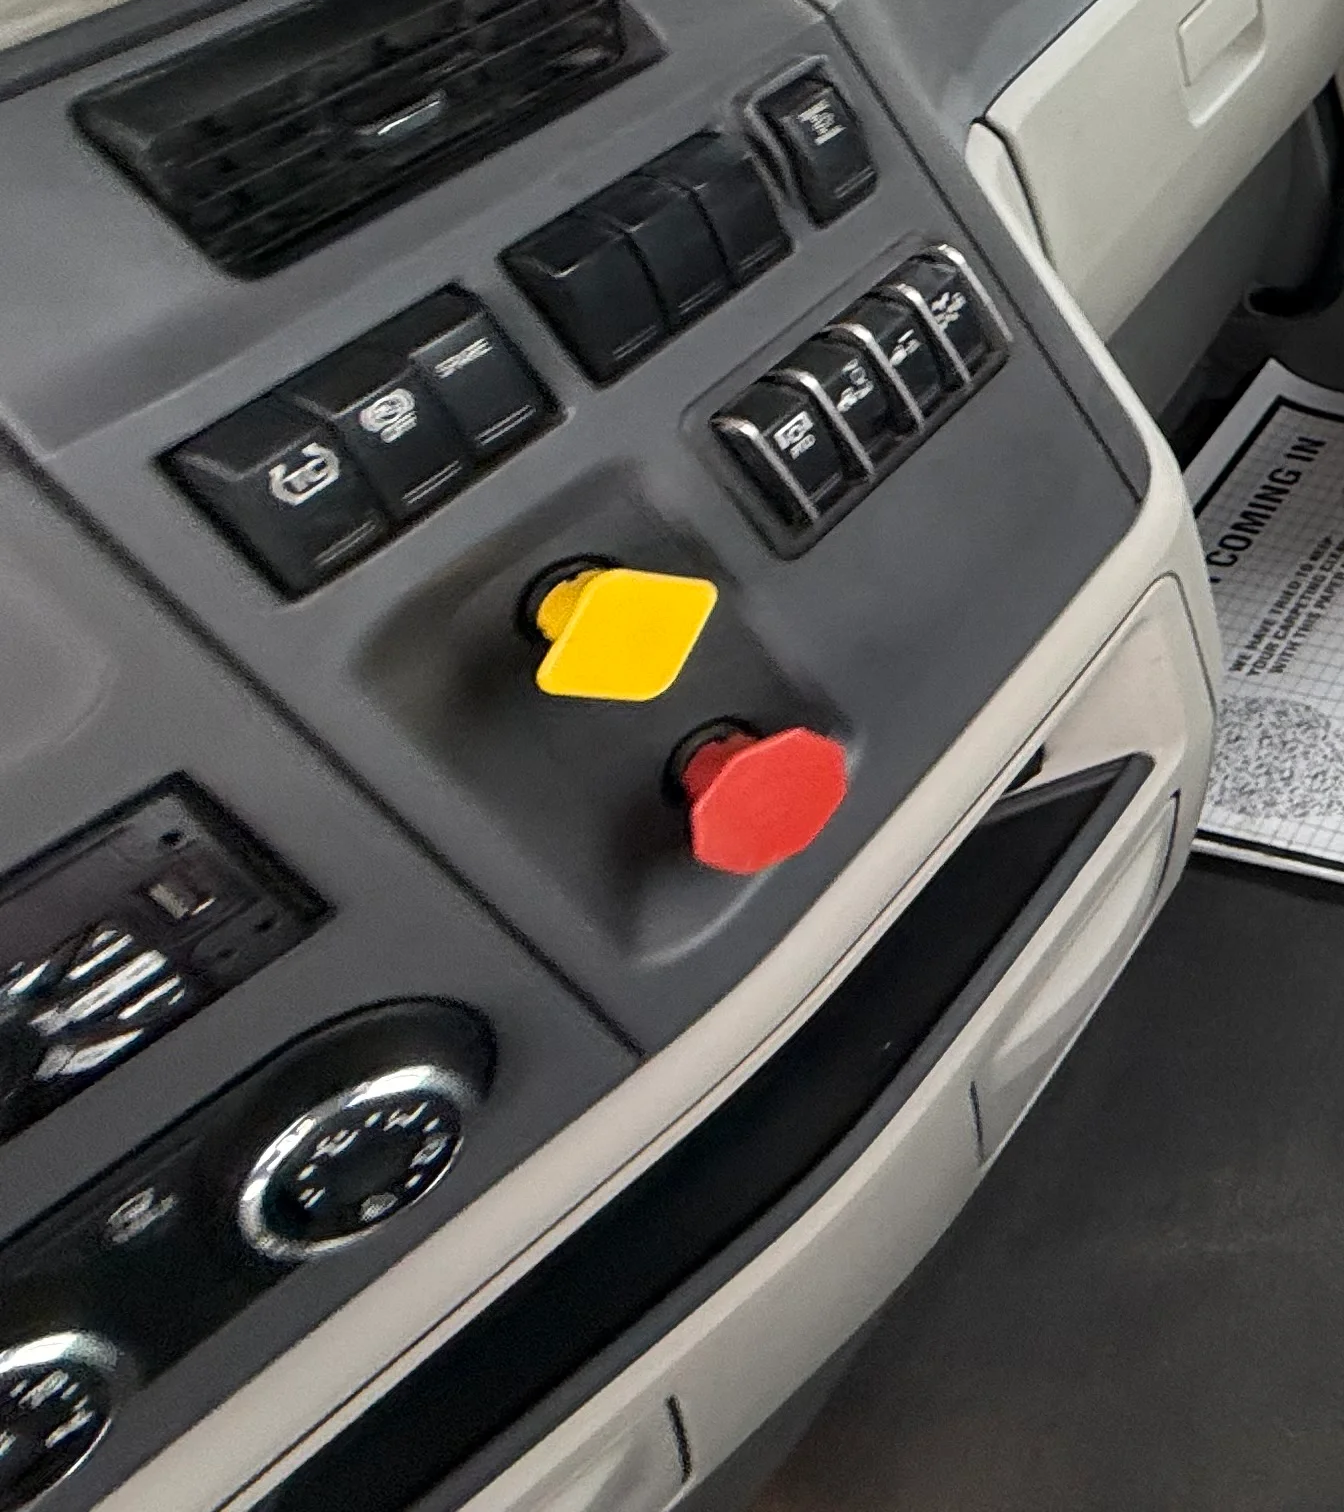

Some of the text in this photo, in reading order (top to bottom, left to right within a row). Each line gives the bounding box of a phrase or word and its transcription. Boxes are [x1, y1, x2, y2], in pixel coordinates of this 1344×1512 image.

[1206, 436, 1327, 567] COMING IN
[1228, 652, 1251, 672] WE
[1245, 617, 1277, 650] HAVE
[1268, 580, 1301, 614] TRIED
[1295, 563, 1314, 578] TO
[1246, 641, 1280, 677] YOUR
[1272, 574, 1327, 640] CARPETING
[1267, 639, 1301, 674] WITH
[1293, 610, 1322, 638] THIS
